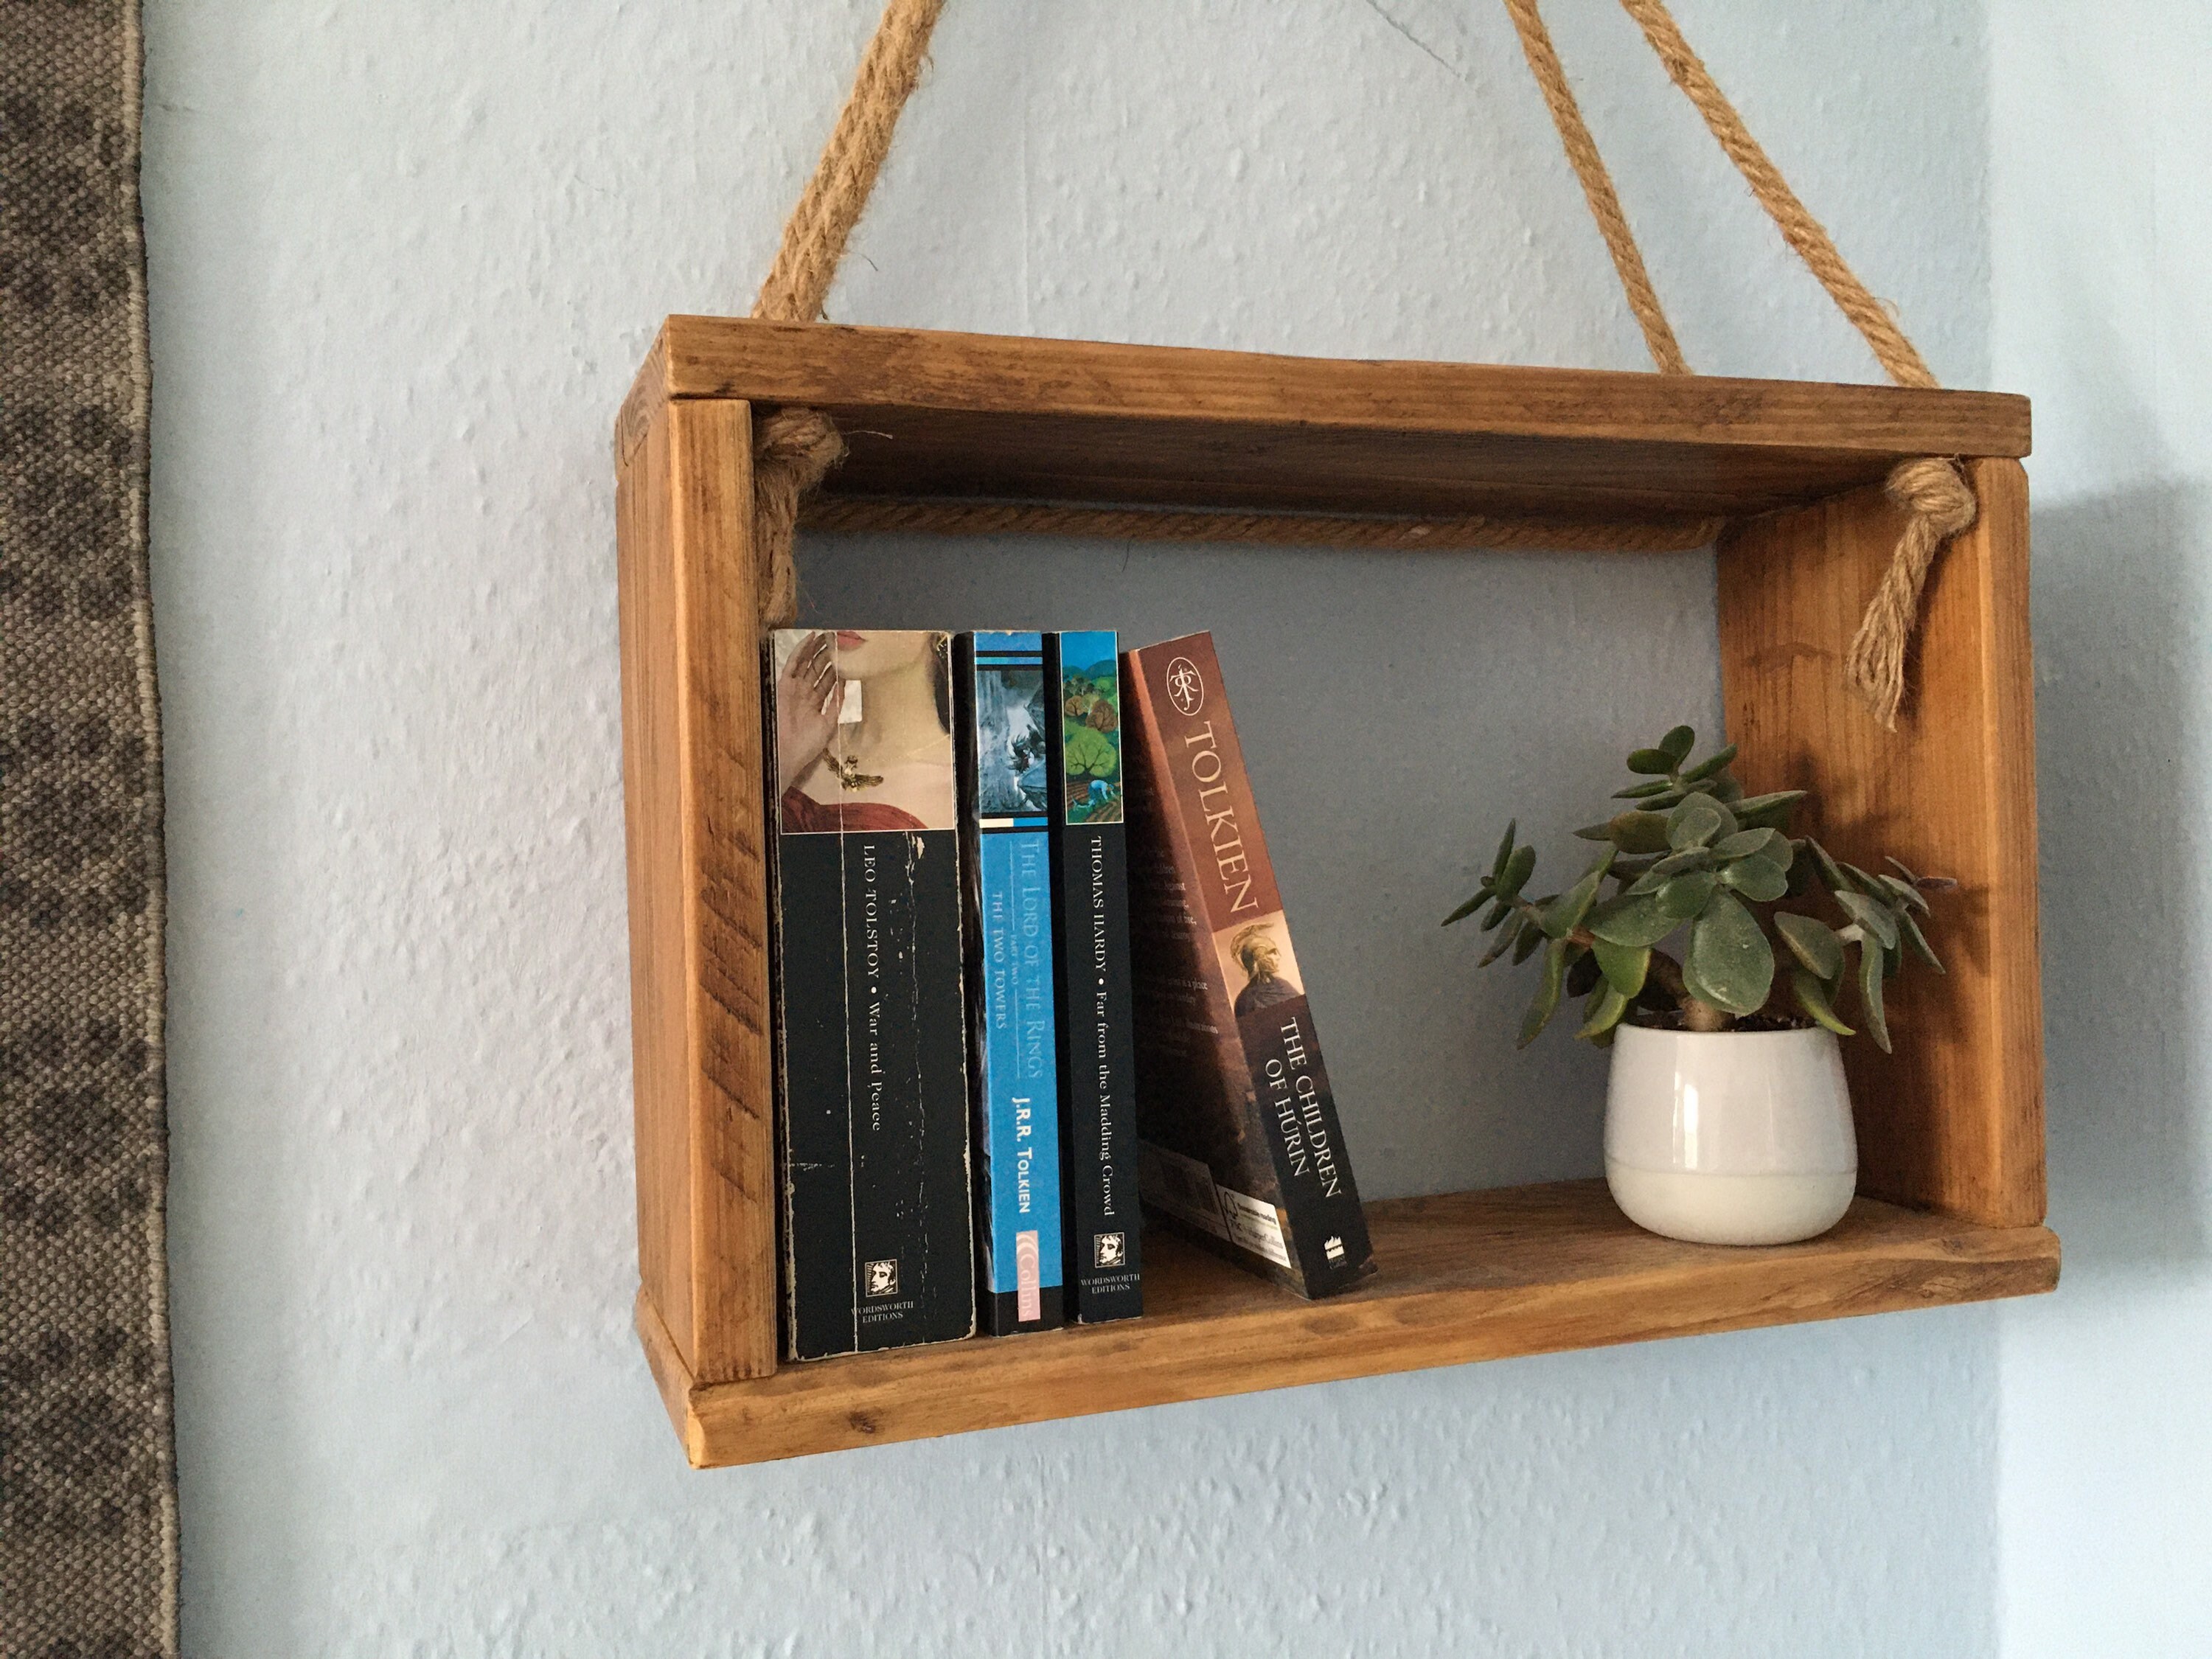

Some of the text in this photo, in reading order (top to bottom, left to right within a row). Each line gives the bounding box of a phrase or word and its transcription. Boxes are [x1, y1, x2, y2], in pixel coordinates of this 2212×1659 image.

[1184, 720, 1259, 914] TOLKIEN
[863, 845, 883, 1132] LEO TOLSTOY War and Peace
[993, 927, 1004, 963] TWO
[995, 970, 1007, 1029] TOWERS
[1021, 840, 1046, 1079] THE LORD OF THE RINGS
[1091, 835, 1116, 1216] THOMAS HARDY Far from the Madding Crowd
[1012, 1097, 1032, 1214] J.R.R. TOLKIEN
[1265, 1059, 1310, 1178] OF HÚRIN
[1281, 1017, 1342, 1198] THE CHILDREN
[863, 1312, 903, 1324] EDITIONS
[1020, 1254, 1037, 1317] Collins
[1081, 1273, 1140, 1286] WORDSWORTH
[1092, 1283, 1130, 1295] EDITIONS
